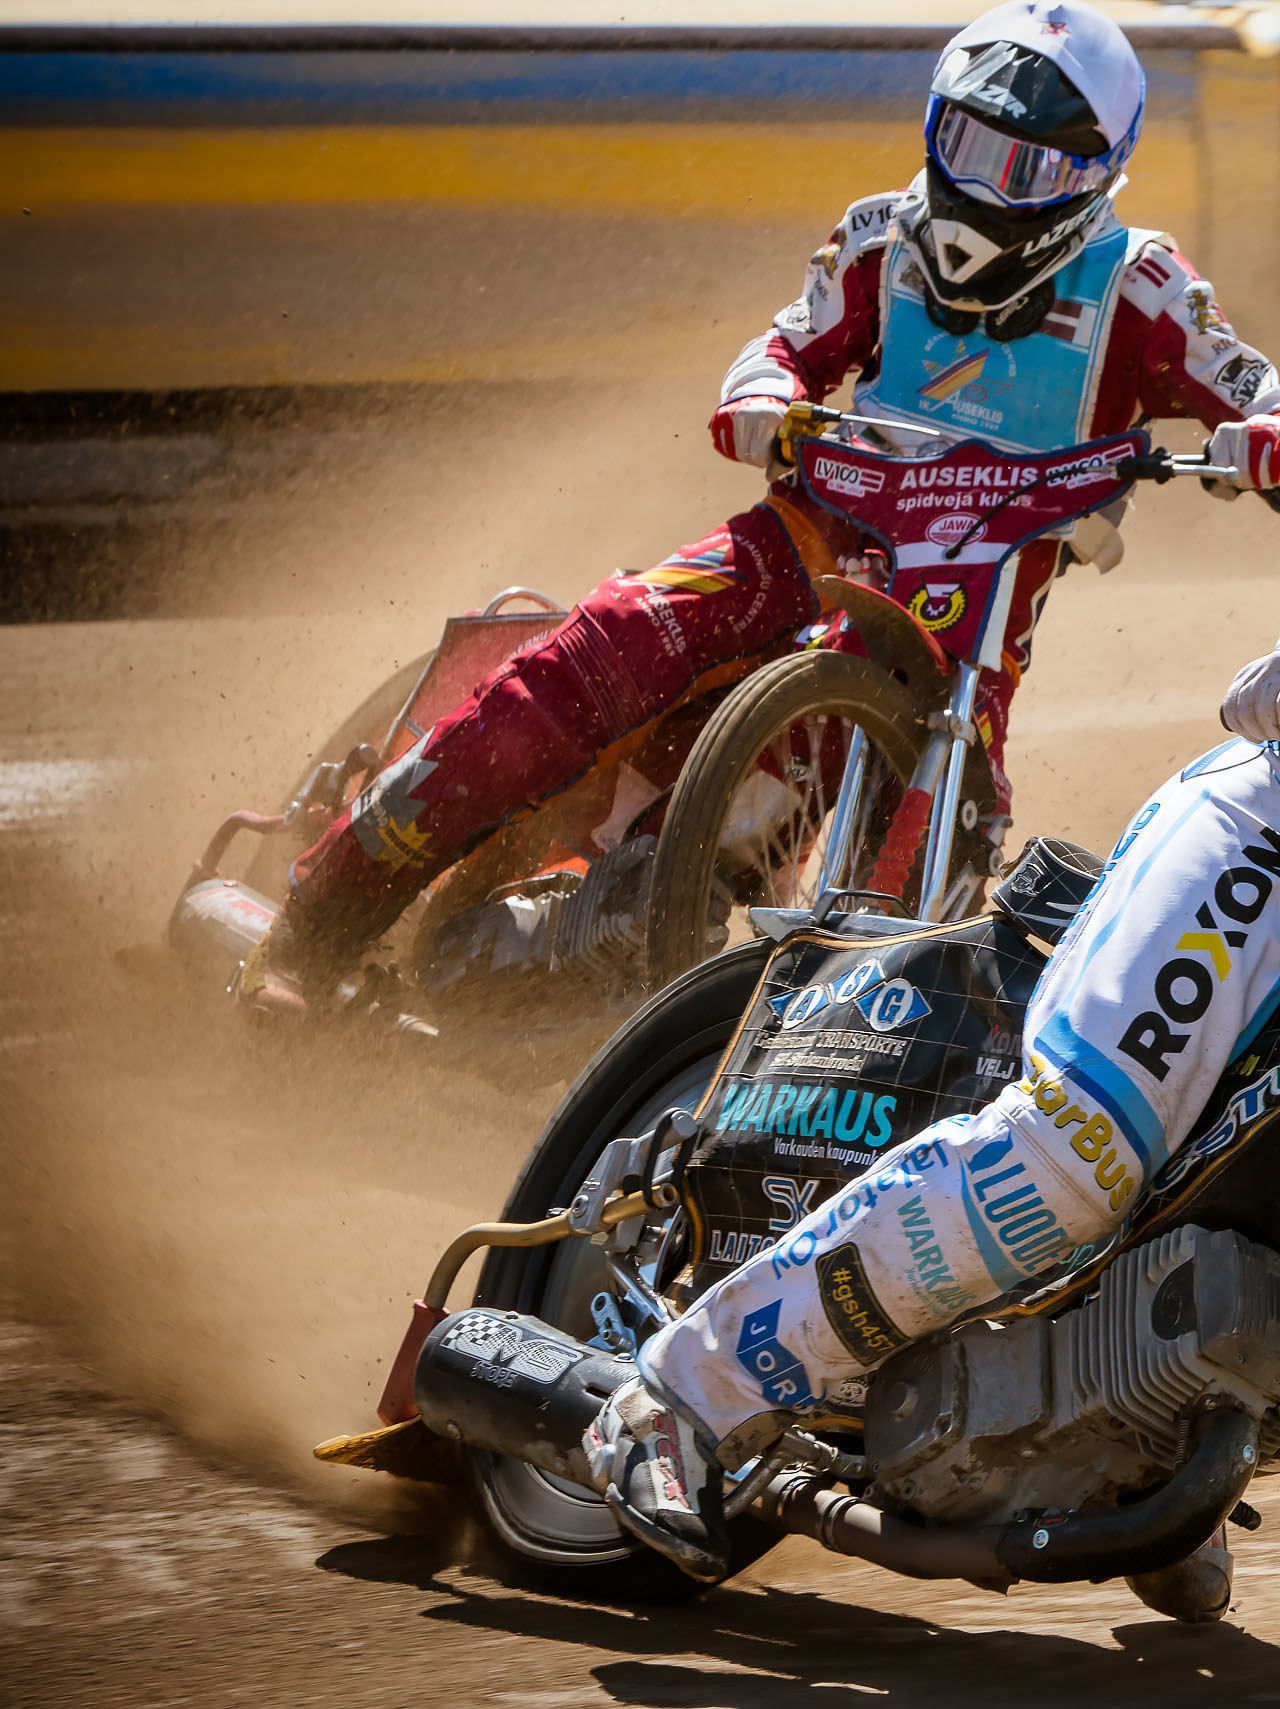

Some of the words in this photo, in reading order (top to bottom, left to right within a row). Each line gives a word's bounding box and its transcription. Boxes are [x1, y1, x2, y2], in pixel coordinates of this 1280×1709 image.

[900, 465, 1039, 490] AUSEKLIS
[938, 518, 976, 532] JAWA
[715, 1083, 898, 1147] WARKAUS
[774, 1137, 825, 1159] Varkauden
[751, 1322, 798, 1403] JOR
